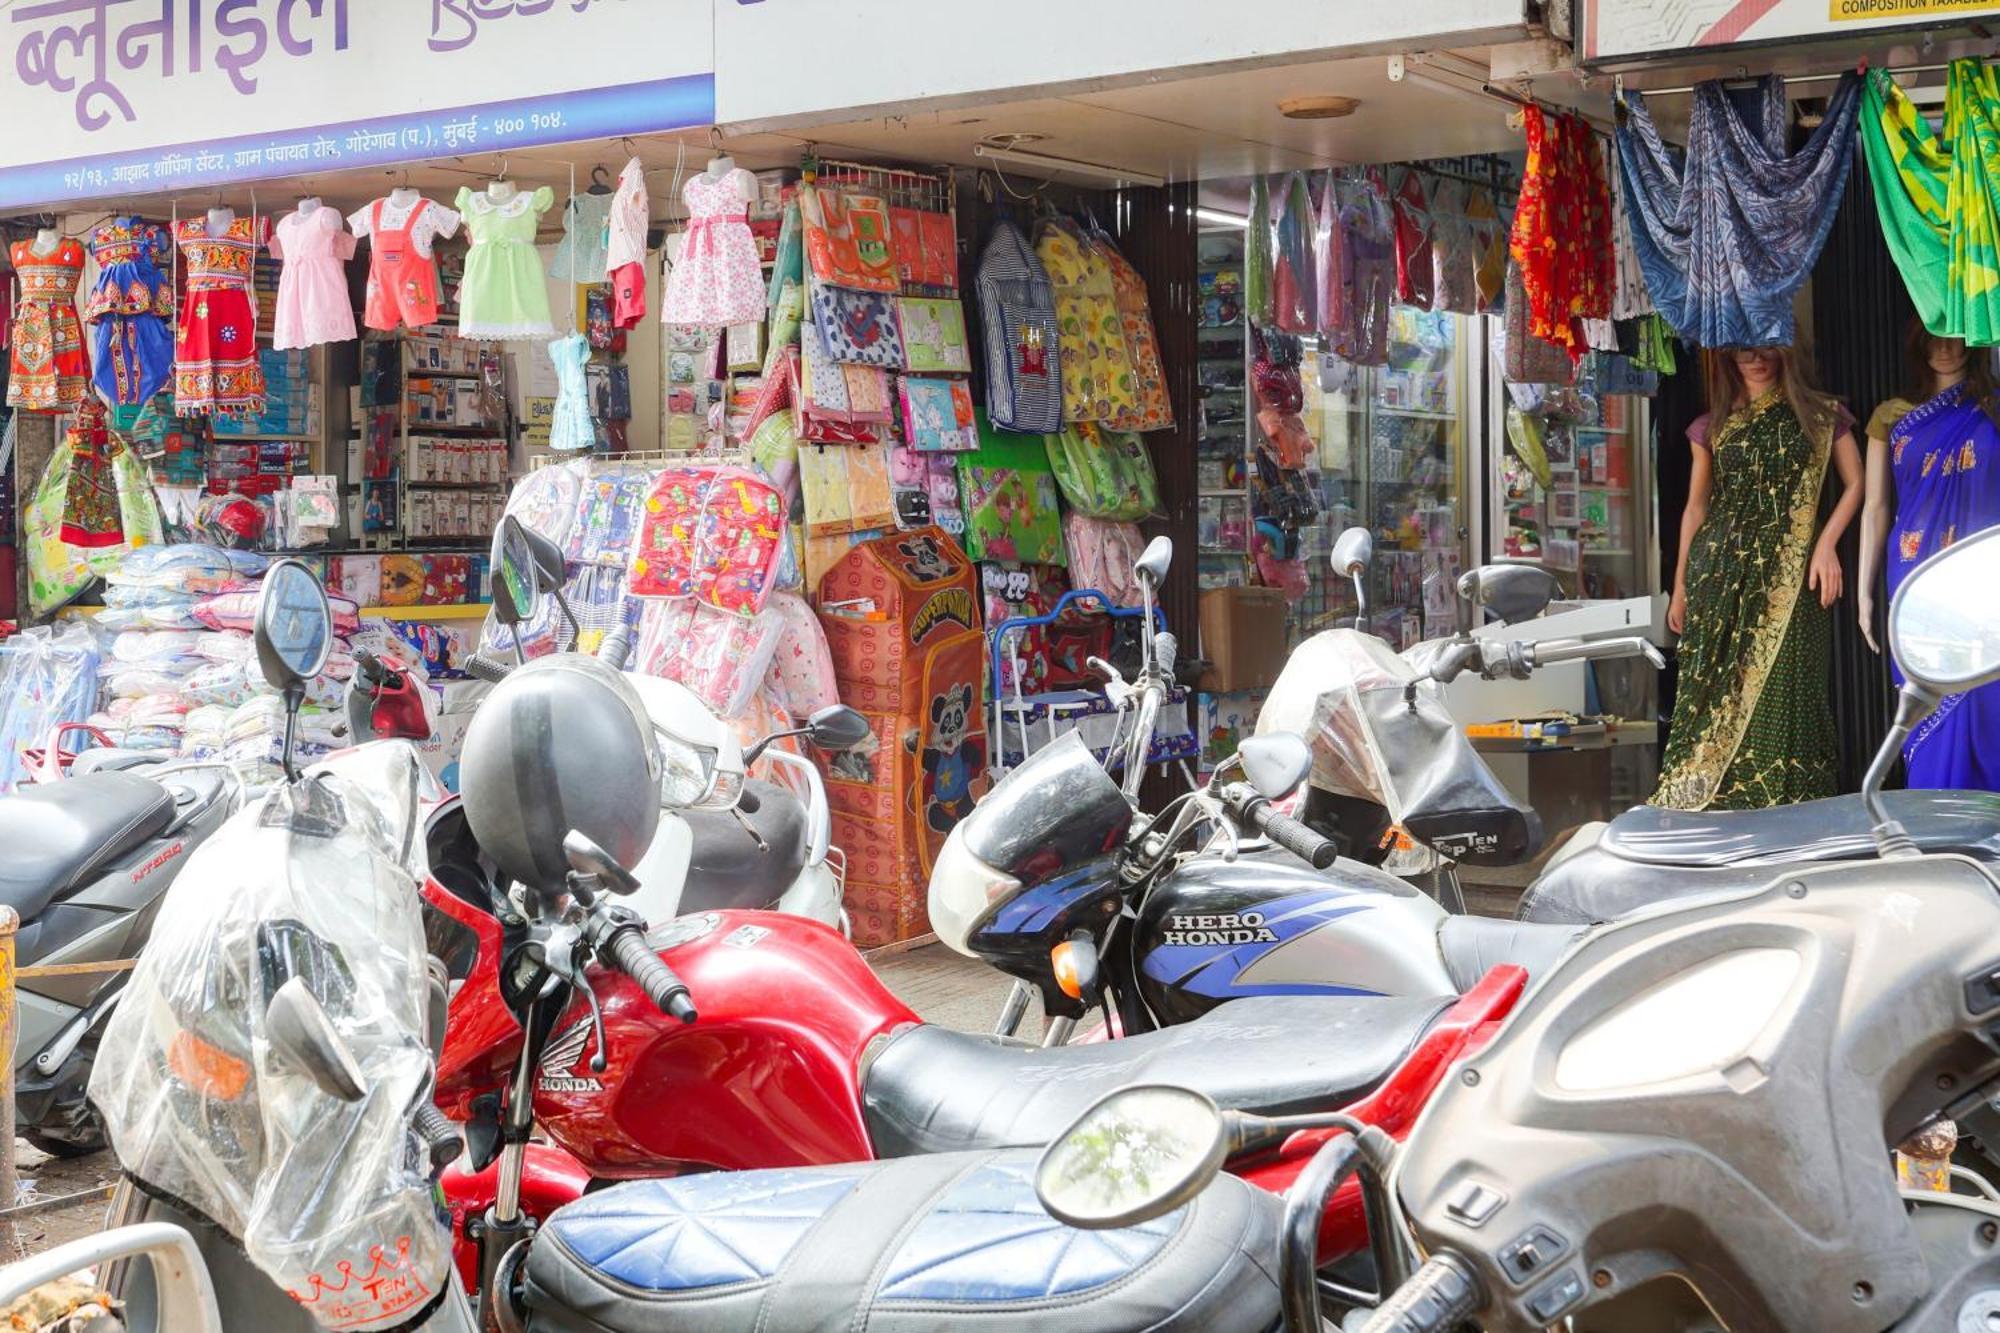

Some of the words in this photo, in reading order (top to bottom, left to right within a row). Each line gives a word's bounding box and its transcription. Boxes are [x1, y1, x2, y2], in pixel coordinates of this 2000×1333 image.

[112, 162, 150, 184] आझाद
[234, 149, 261, 168] ग्राम
[265, 141, 310, 163] पंचायत
[443, 114, 478, 147] मुंबई
[494, 118, 524, 135] ४००
[531, 111, 567, 130] १०४.
[1172, 912, 1265, 930] HERO
[1164, 928, 1281, 946] HONDA
[539, 1078, 604, 1091] HONDA
